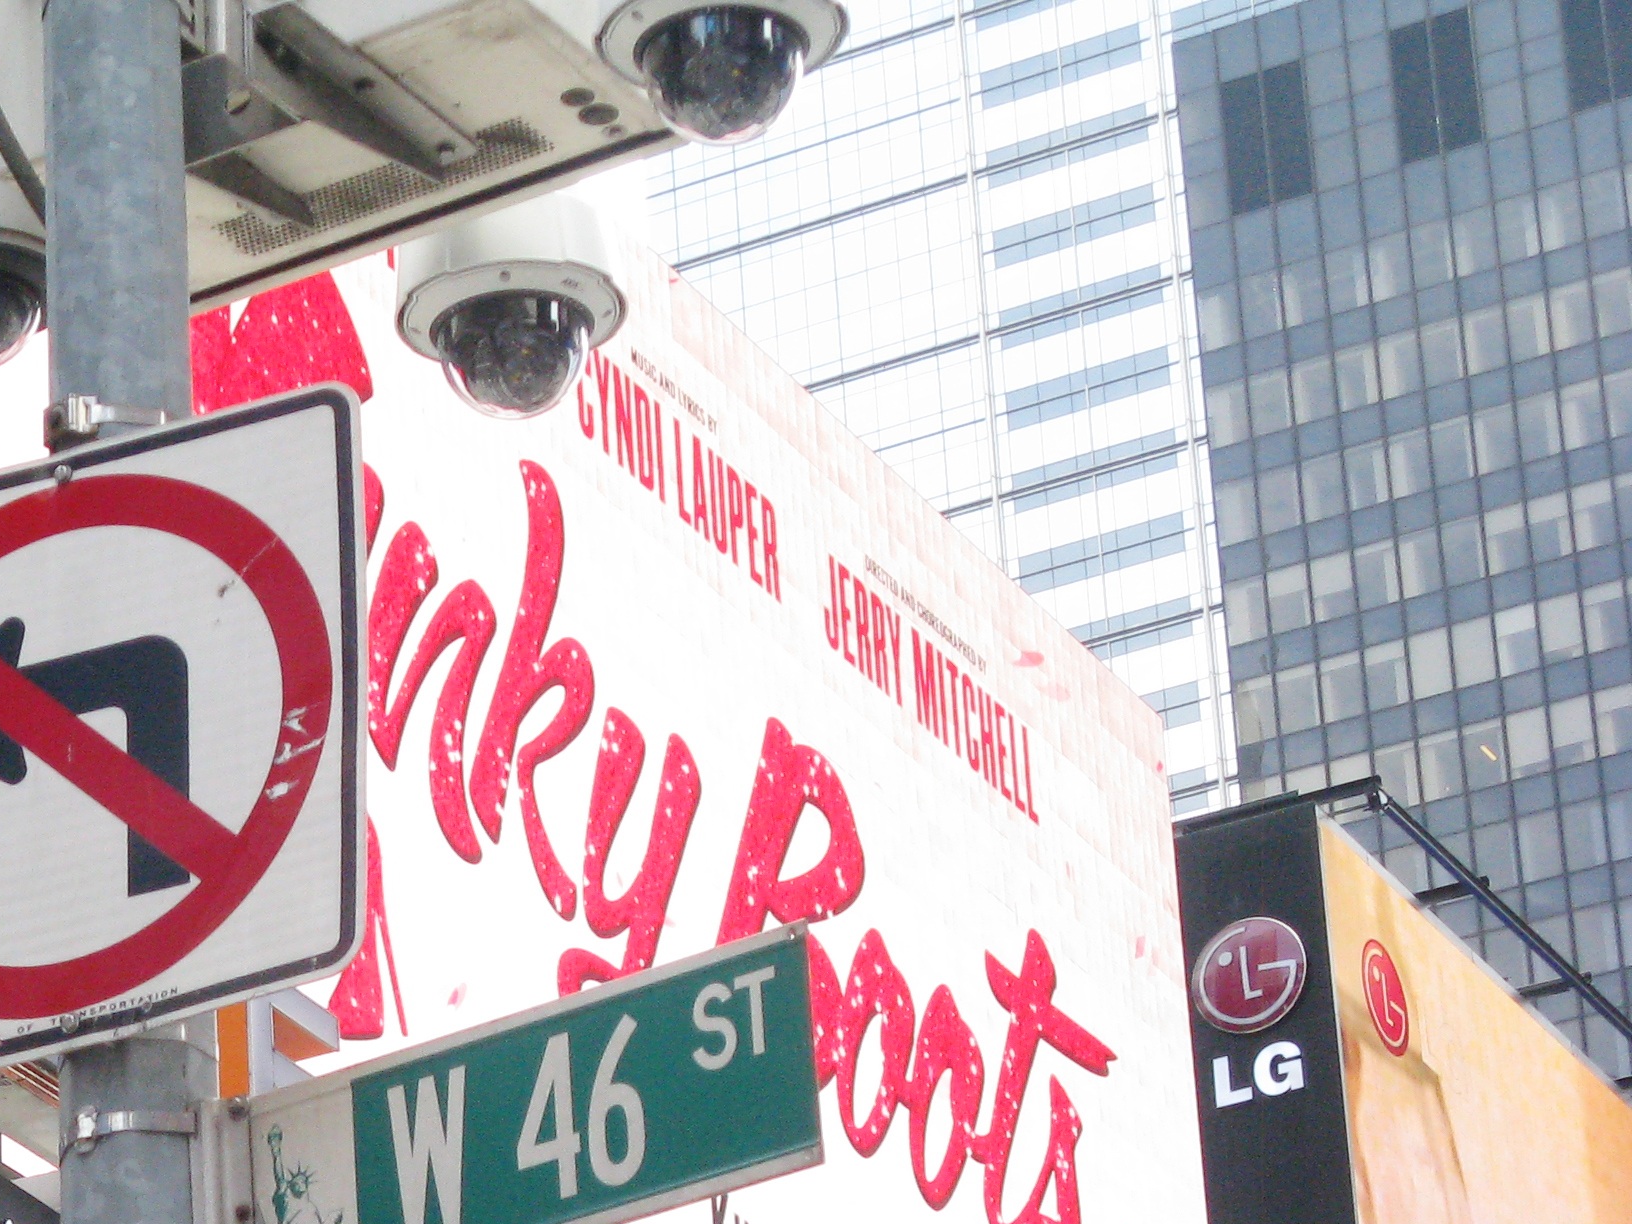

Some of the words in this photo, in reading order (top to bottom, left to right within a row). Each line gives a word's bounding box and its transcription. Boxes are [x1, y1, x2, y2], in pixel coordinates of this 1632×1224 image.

[630, 346, 657, 384] MUSIC
[659, 372, 676, 400] AND
[678, 388, 706, 426] LYRICS
[708, 413, 718, 436] BY
[577, 347, 666, 505] CYNDI
[673, 416, 783, 605] LAUPER
[864, 554, 899, 598] DIRECTED
[901, 589, 916, 612] AND
[917, 601, 977, 664] CHOREOGRAPHED
[978, 659, 988, 676] BY
[823, 553, 903, 708] JERRY
[911, 626, 1040, 826] MITCHELL
[17, 1024, 33, 1034] OF
[51, 986, 179, 1026] TNSPORTATION
[516, 1013, 647, 1199] 46
[691, 966, 777, 1070] ST
[1211, 1040, 1305, 1109] LG
